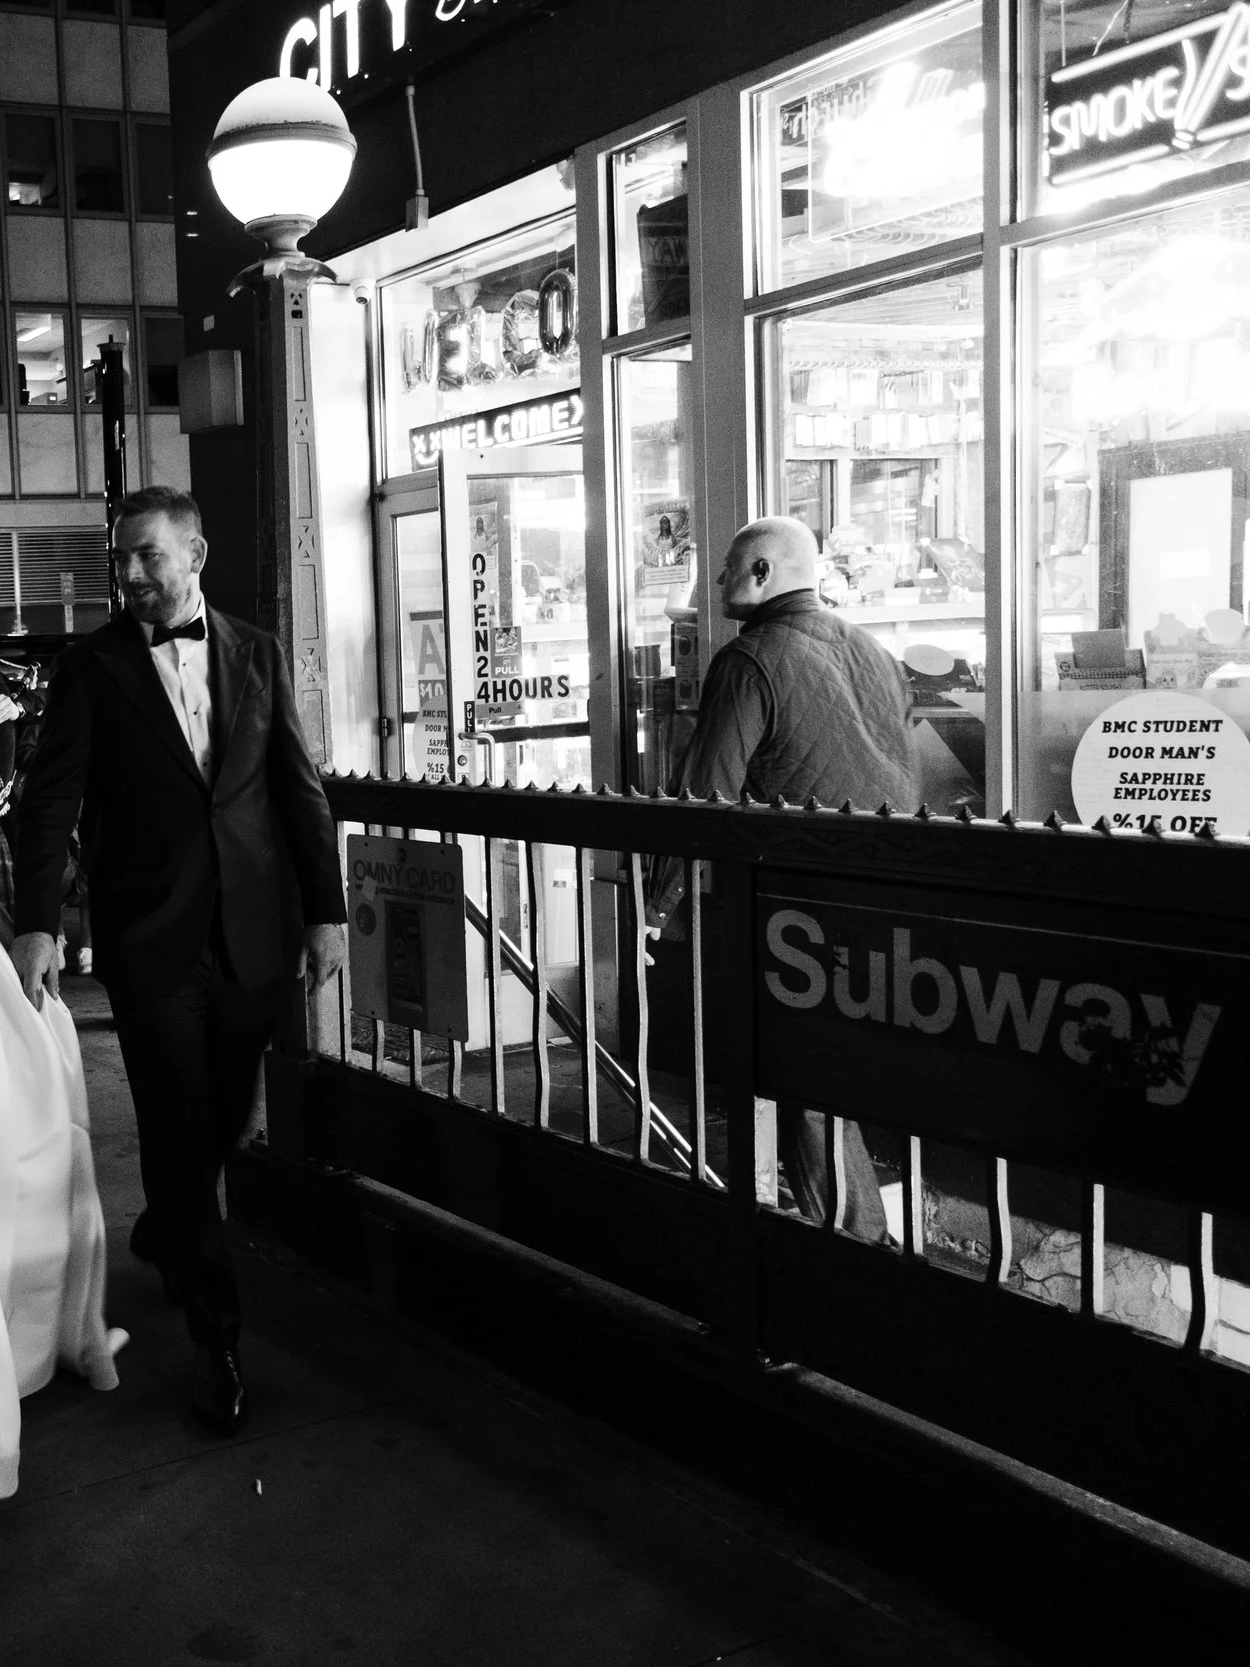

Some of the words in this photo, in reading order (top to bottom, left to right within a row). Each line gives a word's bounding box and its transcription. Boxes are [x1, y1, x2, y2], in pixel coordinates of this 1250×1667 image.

[1049, 66, 1180, 155] SMOKE
[441, 400, 570, 450] WELCOME
[494, 666, 520, 675] PULL
[425, 724, 442, 733] DOOR
[1101, 721, 1138, 733] BMC
[1142, 719, 1224, 733] STUDENT
[1107, 746, 1155, 759] DOOR
[1159, 745, 1217, 760] MAN'S
[1119, 772, 1206, 786] SAPPHIRE
[1113, 788, 1212, 802] EMPLOYEES
[353, 859, 403, 886] OMNY
[406, 866, 456, 894] CARD
[763, 908, 1225, 1106] Subway
